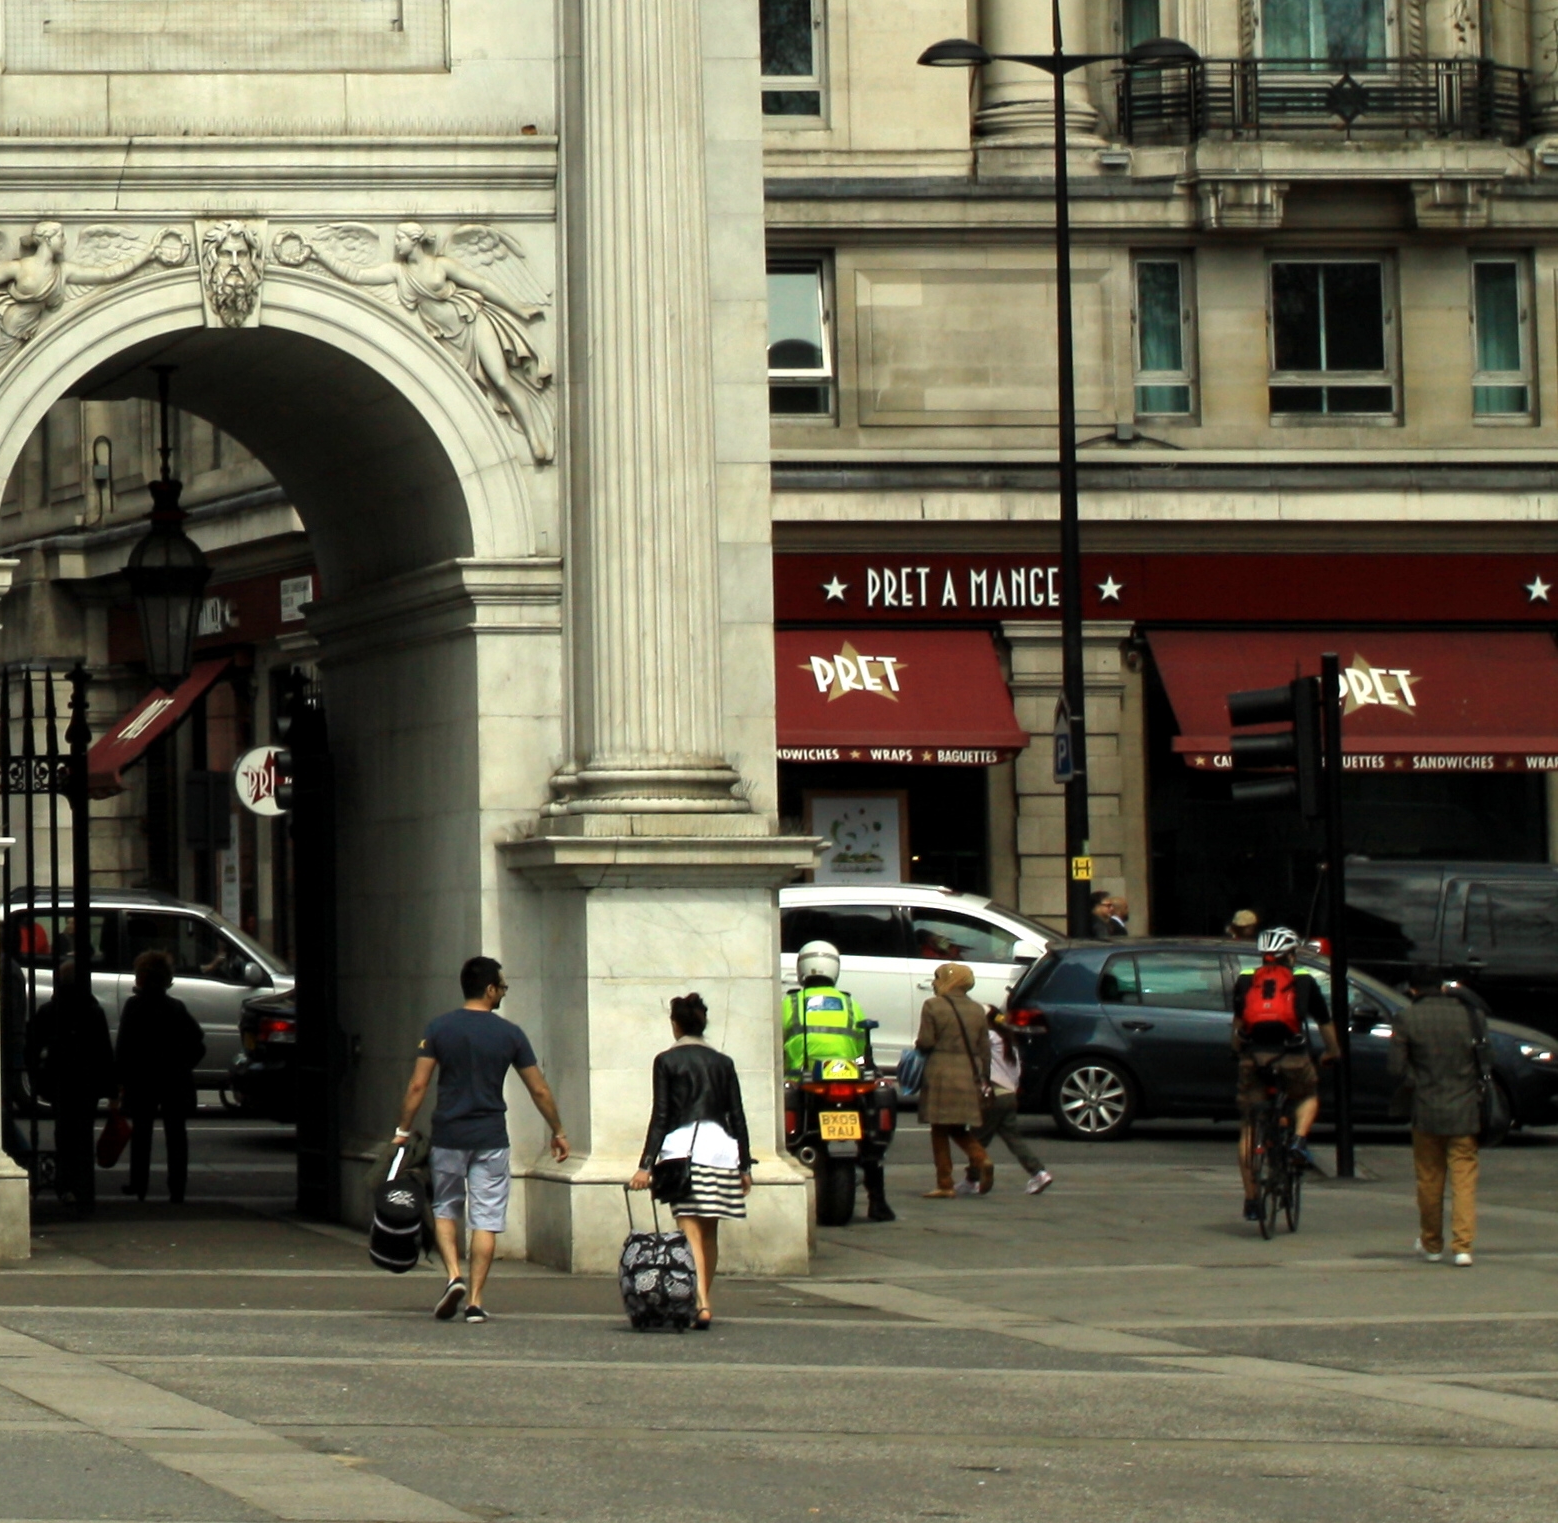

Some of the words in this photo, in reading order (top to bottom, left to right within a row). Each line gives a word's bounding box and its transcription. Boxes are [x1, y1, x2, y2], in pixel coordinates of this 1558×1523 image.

[867, 567, 930, 607] PRET
[941, 569, 958, 607] A
[970, 567, 1061, 607] MANGE
[809, 654, 900, 693] PRET
[776, 748, 840, 761] NDWICHES
[870, 749, 914, 762] WRAPS
[937, 749, 998, 764] BAGUETTES
[1412, 755, 1494, 769] SANDWICHES
[247, 765, 275, 797] PR
[827, 1126, 854, 1136] RAU
